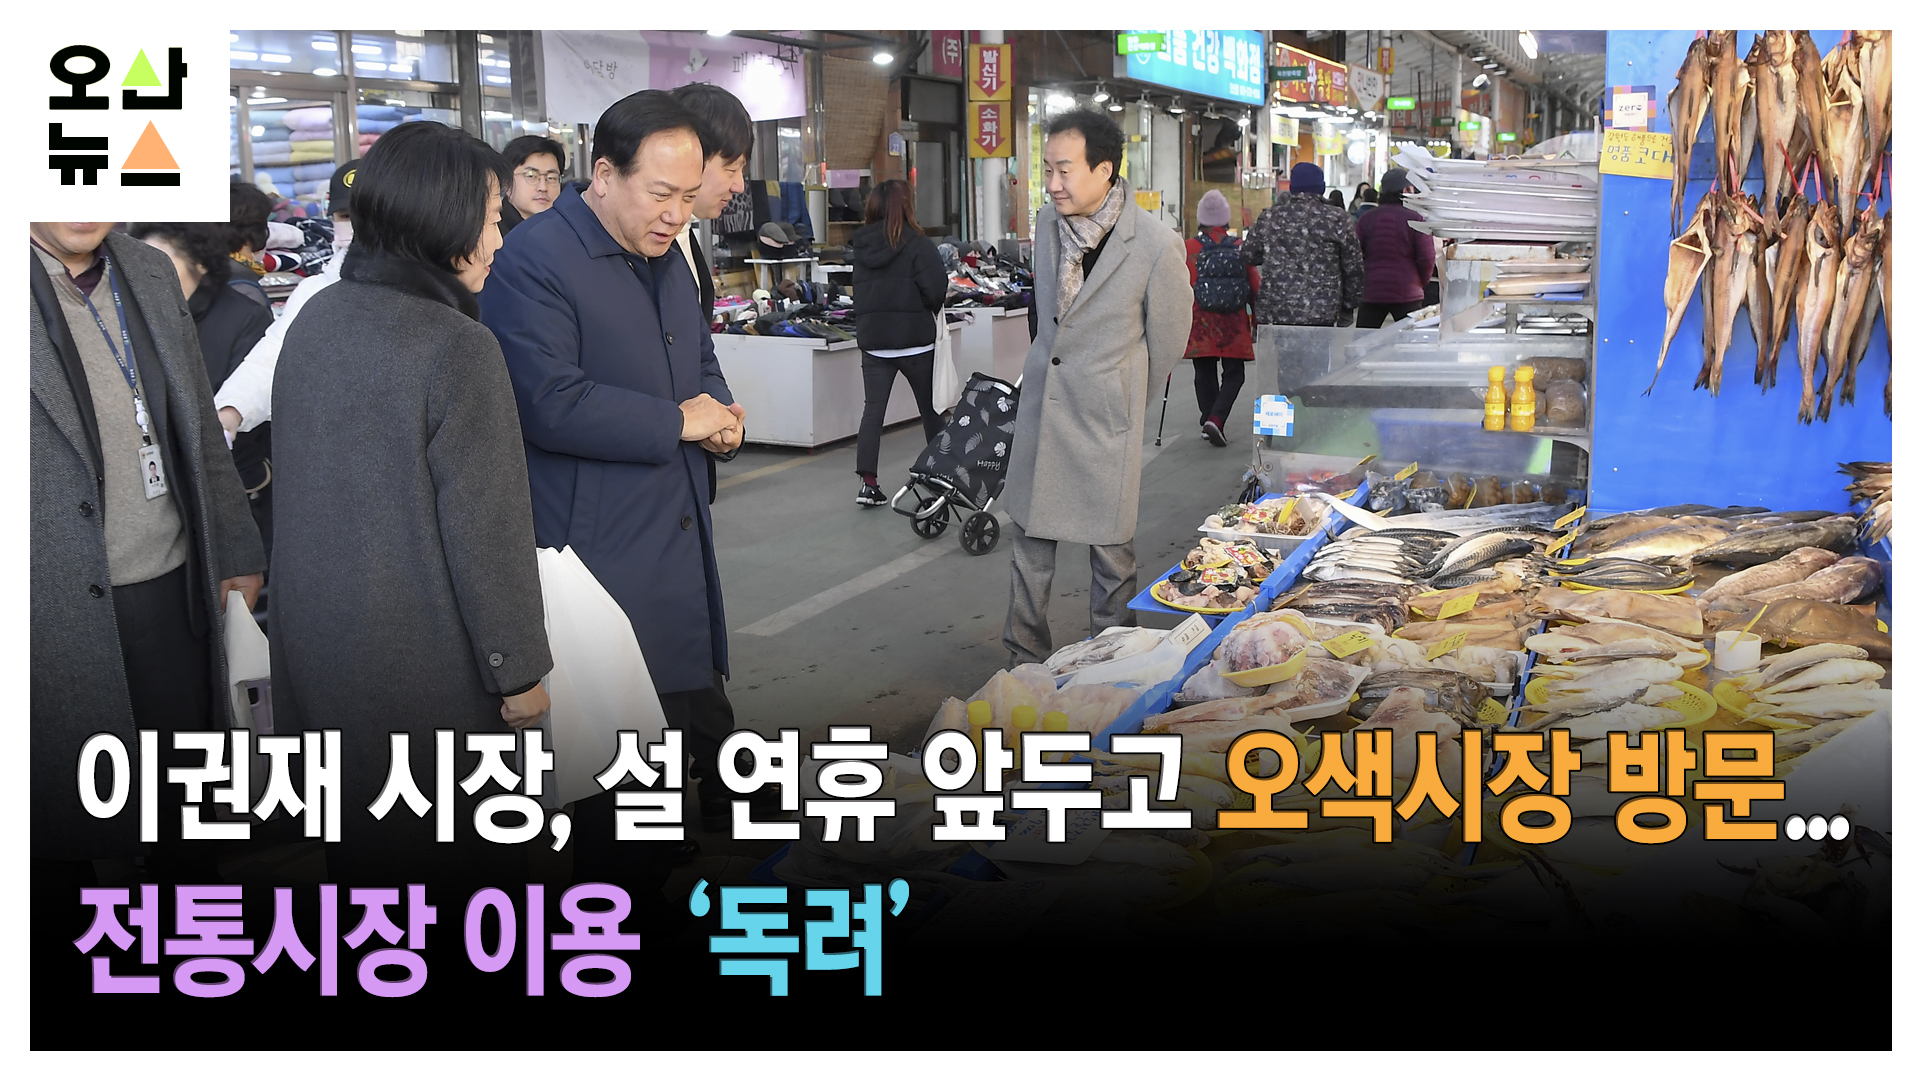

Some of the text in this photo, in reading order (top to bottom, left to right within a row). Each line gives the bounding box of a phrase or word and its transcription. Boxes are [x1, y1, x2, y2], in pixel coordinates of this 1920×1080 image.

[982, 50, 999, 91] 발신기
[1191, 30, 1220, 74] 건강
[1223, 35, 1261, 85] 백화점
[1618, 104, 1642, 112] zero
[981, 108, 998, 148] 소화기
[1607, 145, 1632, 163] 명품
[977, 460, 1001, 472] Happy
